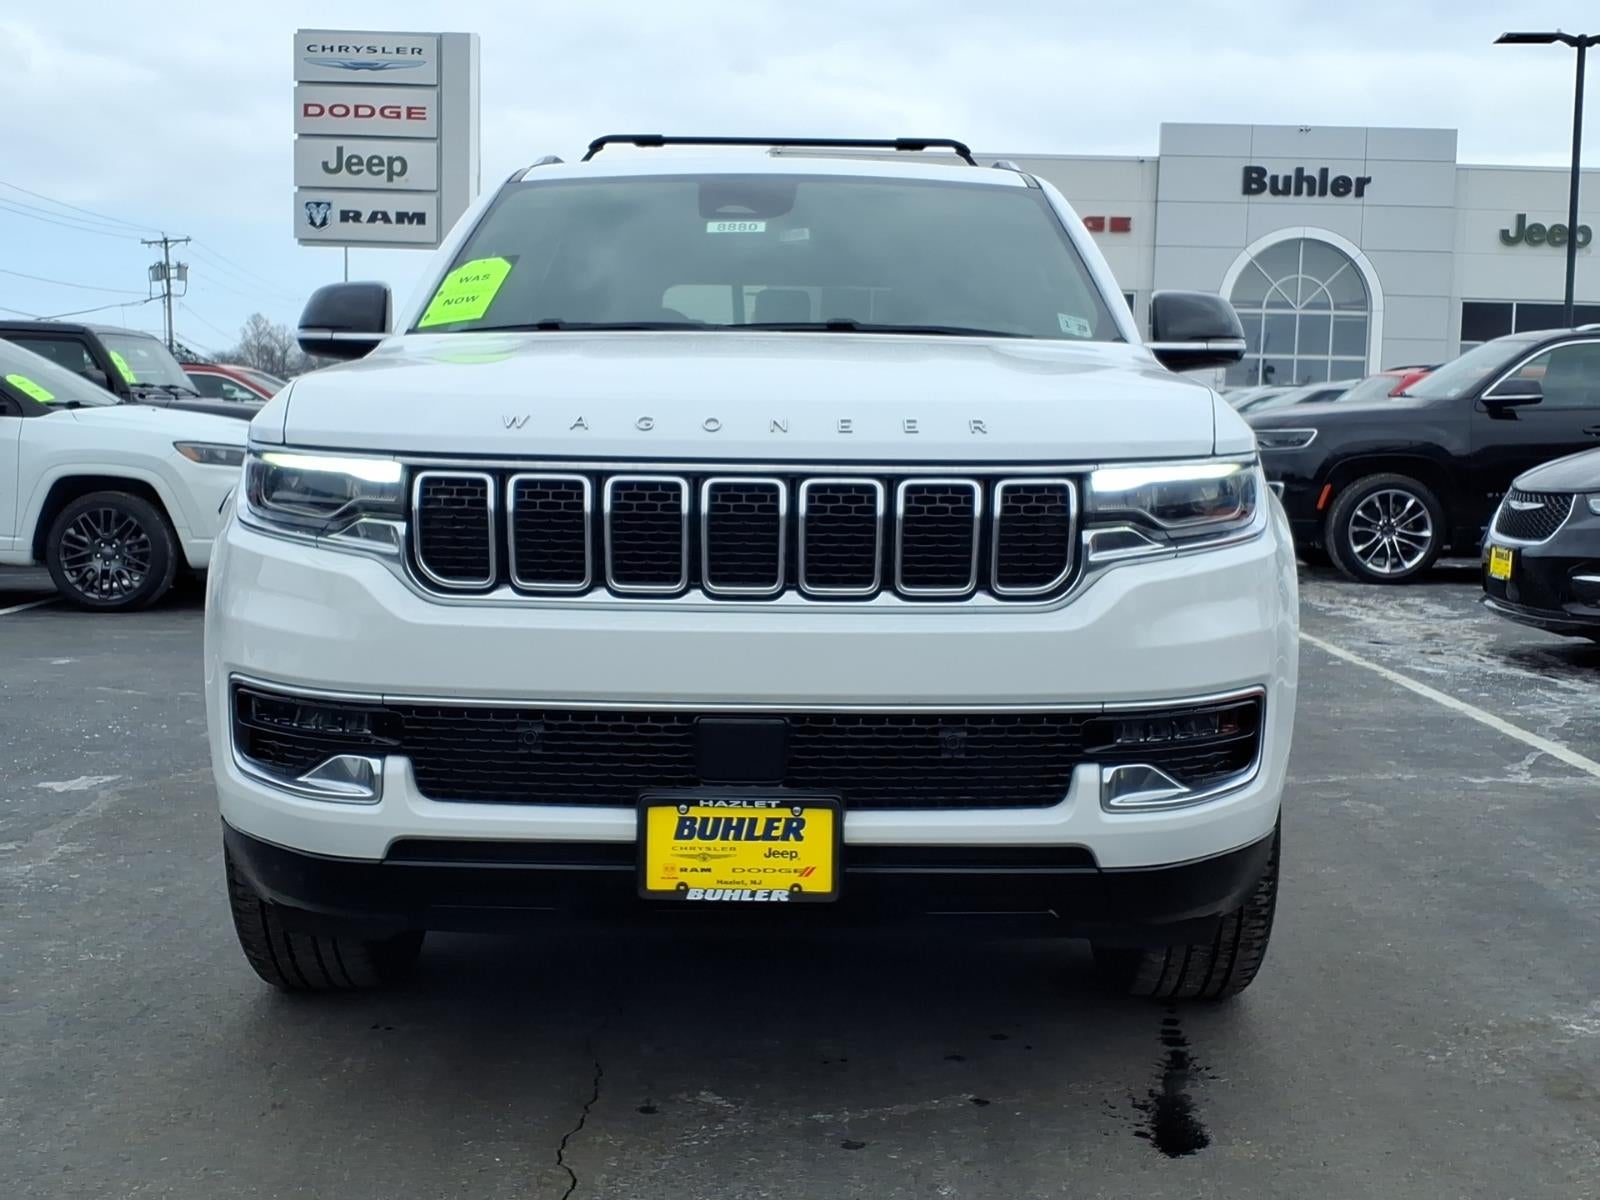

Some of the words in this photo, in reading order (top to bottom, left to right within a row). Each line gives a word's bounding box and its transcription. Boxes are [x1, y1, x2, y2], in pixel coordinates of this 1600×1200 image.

[306, 44, 424, 56] CHRYSLER
[303, 103, 427, 120] DODGE
[321, 146, 408, 183] Jeep
[1242, 165, 1372, 198] Buhler
[339, 209, 426, 225] RAM
[459, 273, 491, 284] WAS
[442, 295, 480, 307] NOW
[501, 413, 988, 435] WAGONEER
[699, 799, 781, 808] HAZLET
[673, 815, 806, 842] BUHLER
[763, 848, 799, 861] Jeep
[686, 888, 790, 902] BUHLER
